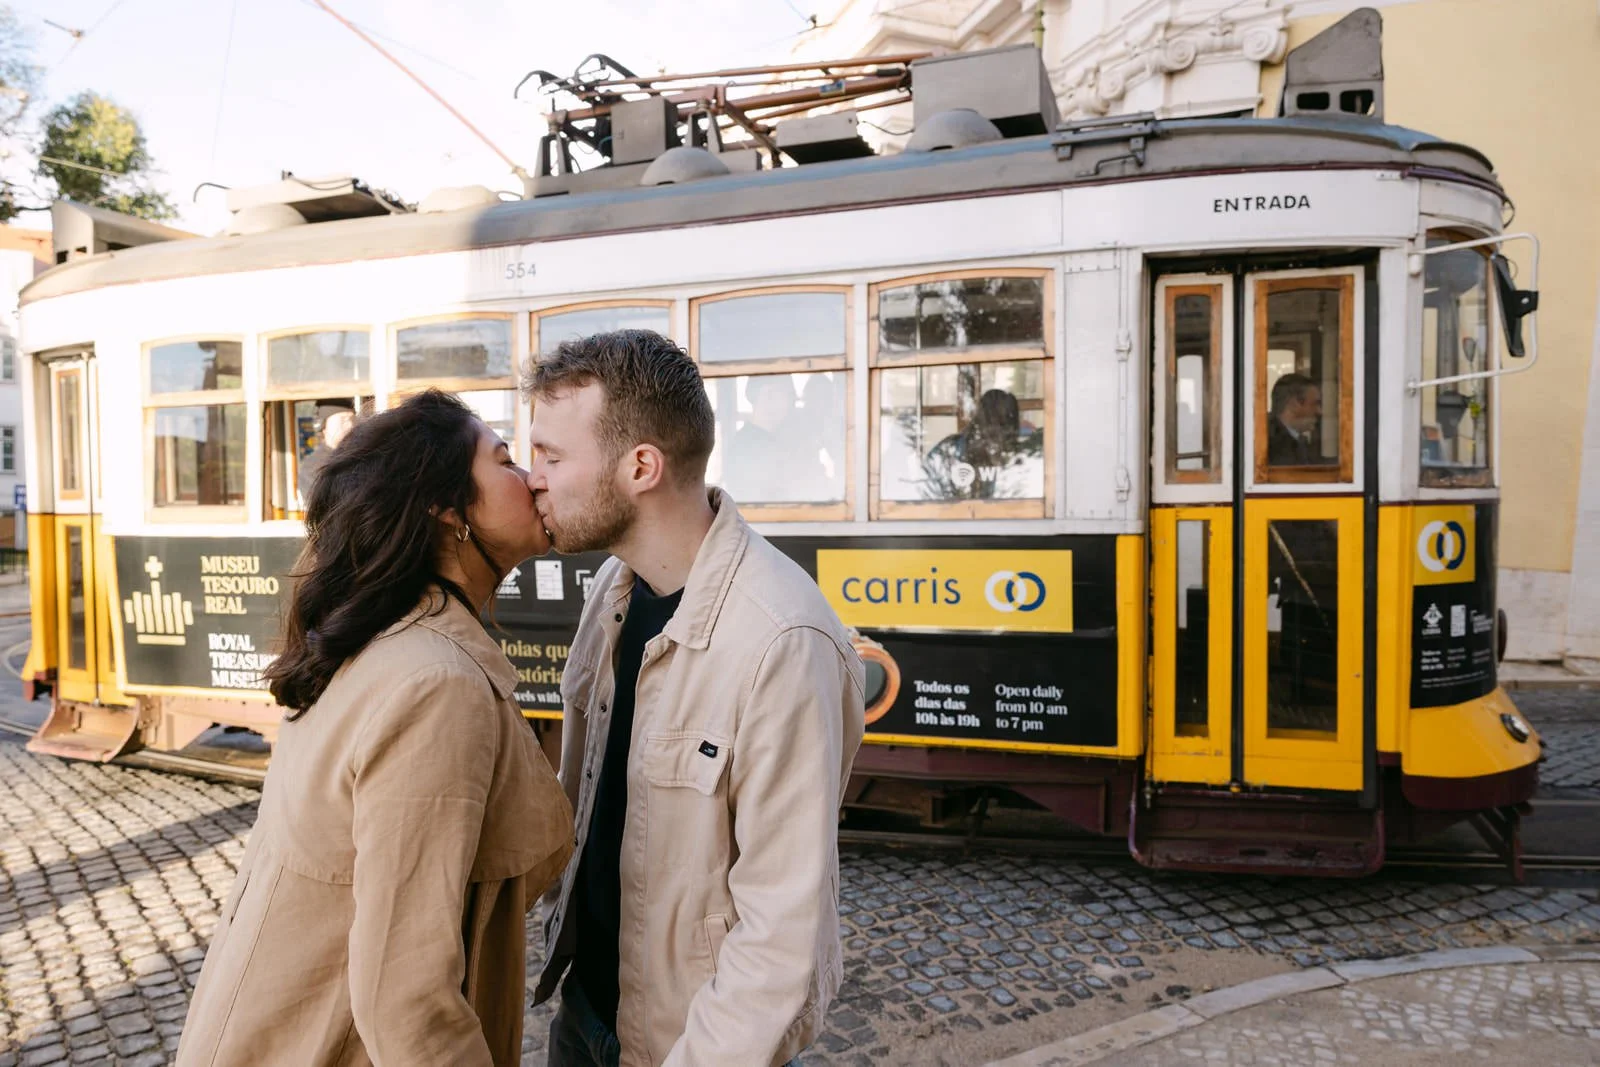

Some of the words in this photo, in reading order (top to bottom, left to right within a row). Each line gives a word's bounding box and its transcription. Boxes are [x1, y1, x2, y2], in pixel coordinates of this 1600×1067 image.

[1213, 195, 1311, 213] ENTRADA
[200, 555, 260, 574] MUSEU
[201, 576, 279, 595] TESOURO
[842, 567, 961, 605] carris
[204, 596, 247, 615] REAL
[208, 633, 256, 652] ROYAL
[545, 644, 571, 662] qu
[519, 665, 563, 684] stória
[914, 680, 952, 694] Todos
[954, 684, 970, 695] os
[995, 683, 1030, 699] Open
[1032, 685, 1064, 701] daily
[537, 691, 561, 704] with
[914, 696, 941, 709] dias
[943, 698, 967, 710] das
[995, 700, 1027, 714] from
[1029, 701, 1044, 715] 10
[1046, 705, 1068, 716] am
[915, 712, 938, 725] 10h
[940, 712, 956, 726] às
[957, 714, 981, 728] 19h
[996, 717, 1009, 729] to
[1011, 717, 1020, 729] 7
[1022, 721, 1044, 733] pm
